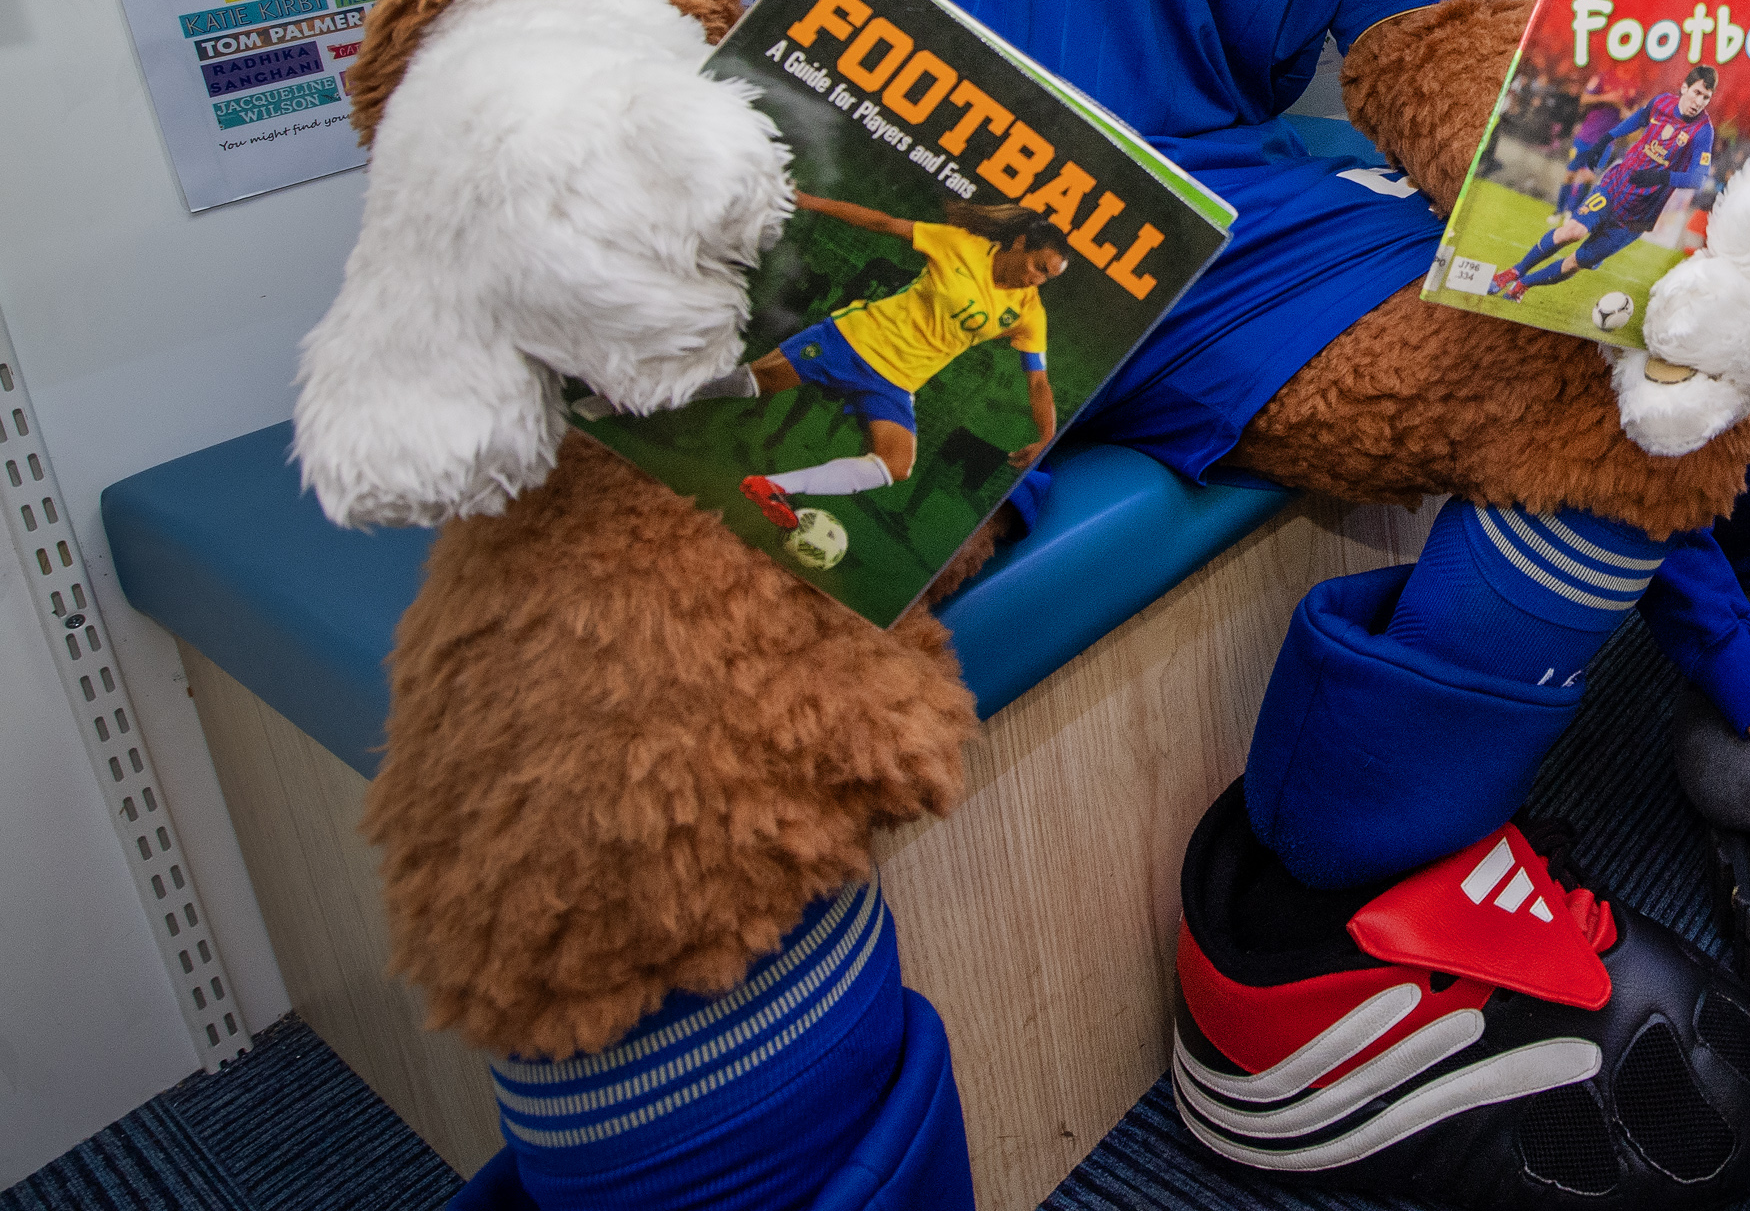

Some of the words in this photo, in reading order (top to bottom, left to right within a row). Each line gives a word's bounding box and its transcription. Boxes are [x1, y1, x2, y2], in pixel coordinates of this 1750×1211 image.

[186, 6, 252, 36] KATIE
[201, 33, 263, 57] TOM
[269, 11, 363, 43] PALMER
[210, 59, 321, 93] SANGHANI
[213, 47, 311, 77] RADHIKA
[216, 77, 335, 116] JACQUELINE
[239, 94, 320, 123] WILSON
[765, 40, 788, 62] A
[784, 51, 832, 93] Guide
[828, 83, 858, 111] for
[852, 100, 913, 151] Players
[908, 145, 946, 174] and
[937, 162, 978, 200] Fans
[951, 298, 986, 332] 10
